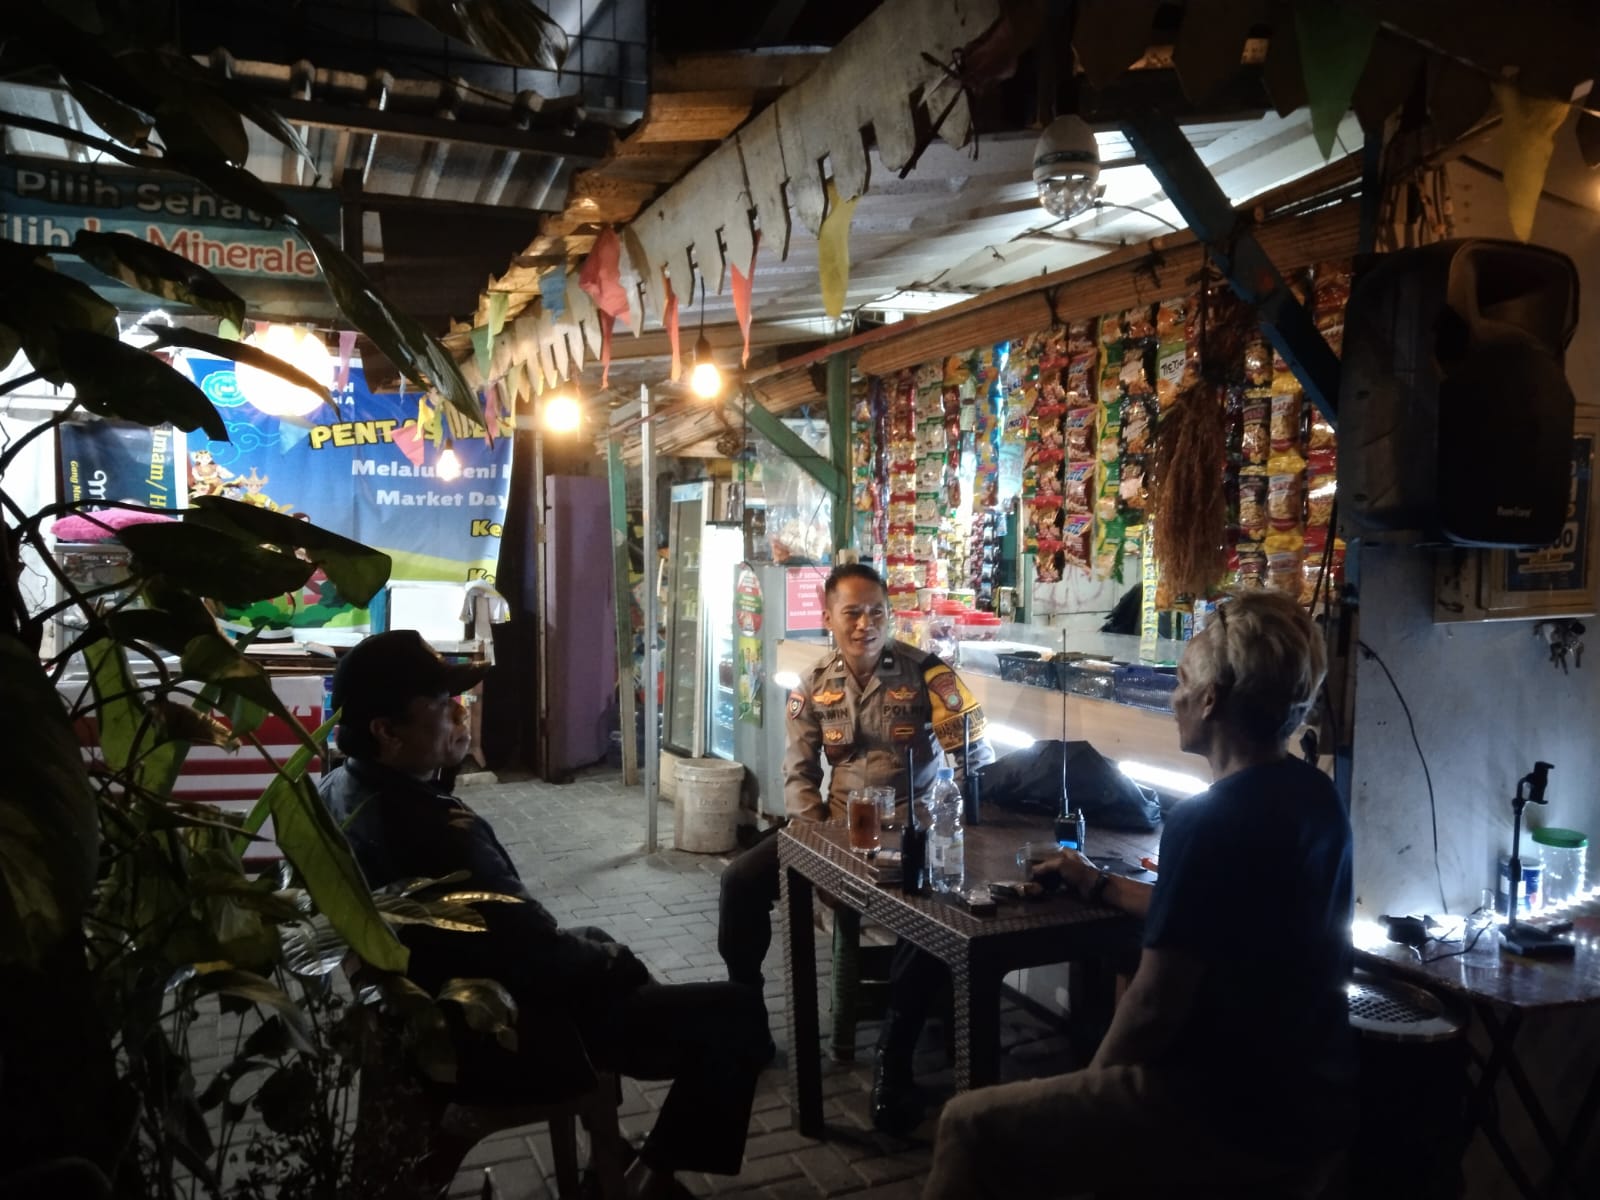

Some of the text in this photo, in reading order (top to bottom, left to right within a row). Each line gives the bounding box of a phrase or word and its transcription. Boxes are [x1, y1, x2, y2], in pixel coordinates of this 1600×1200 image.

[16, 168, 120, 206] Pilih
[148, 225, 317, 276] Minerale
[70, 460, 79, 483] Gang
[352, 459, 442, 478] Melalu
[457, 463, 497, 479] eni
[376, 489, 463, 507] Market
